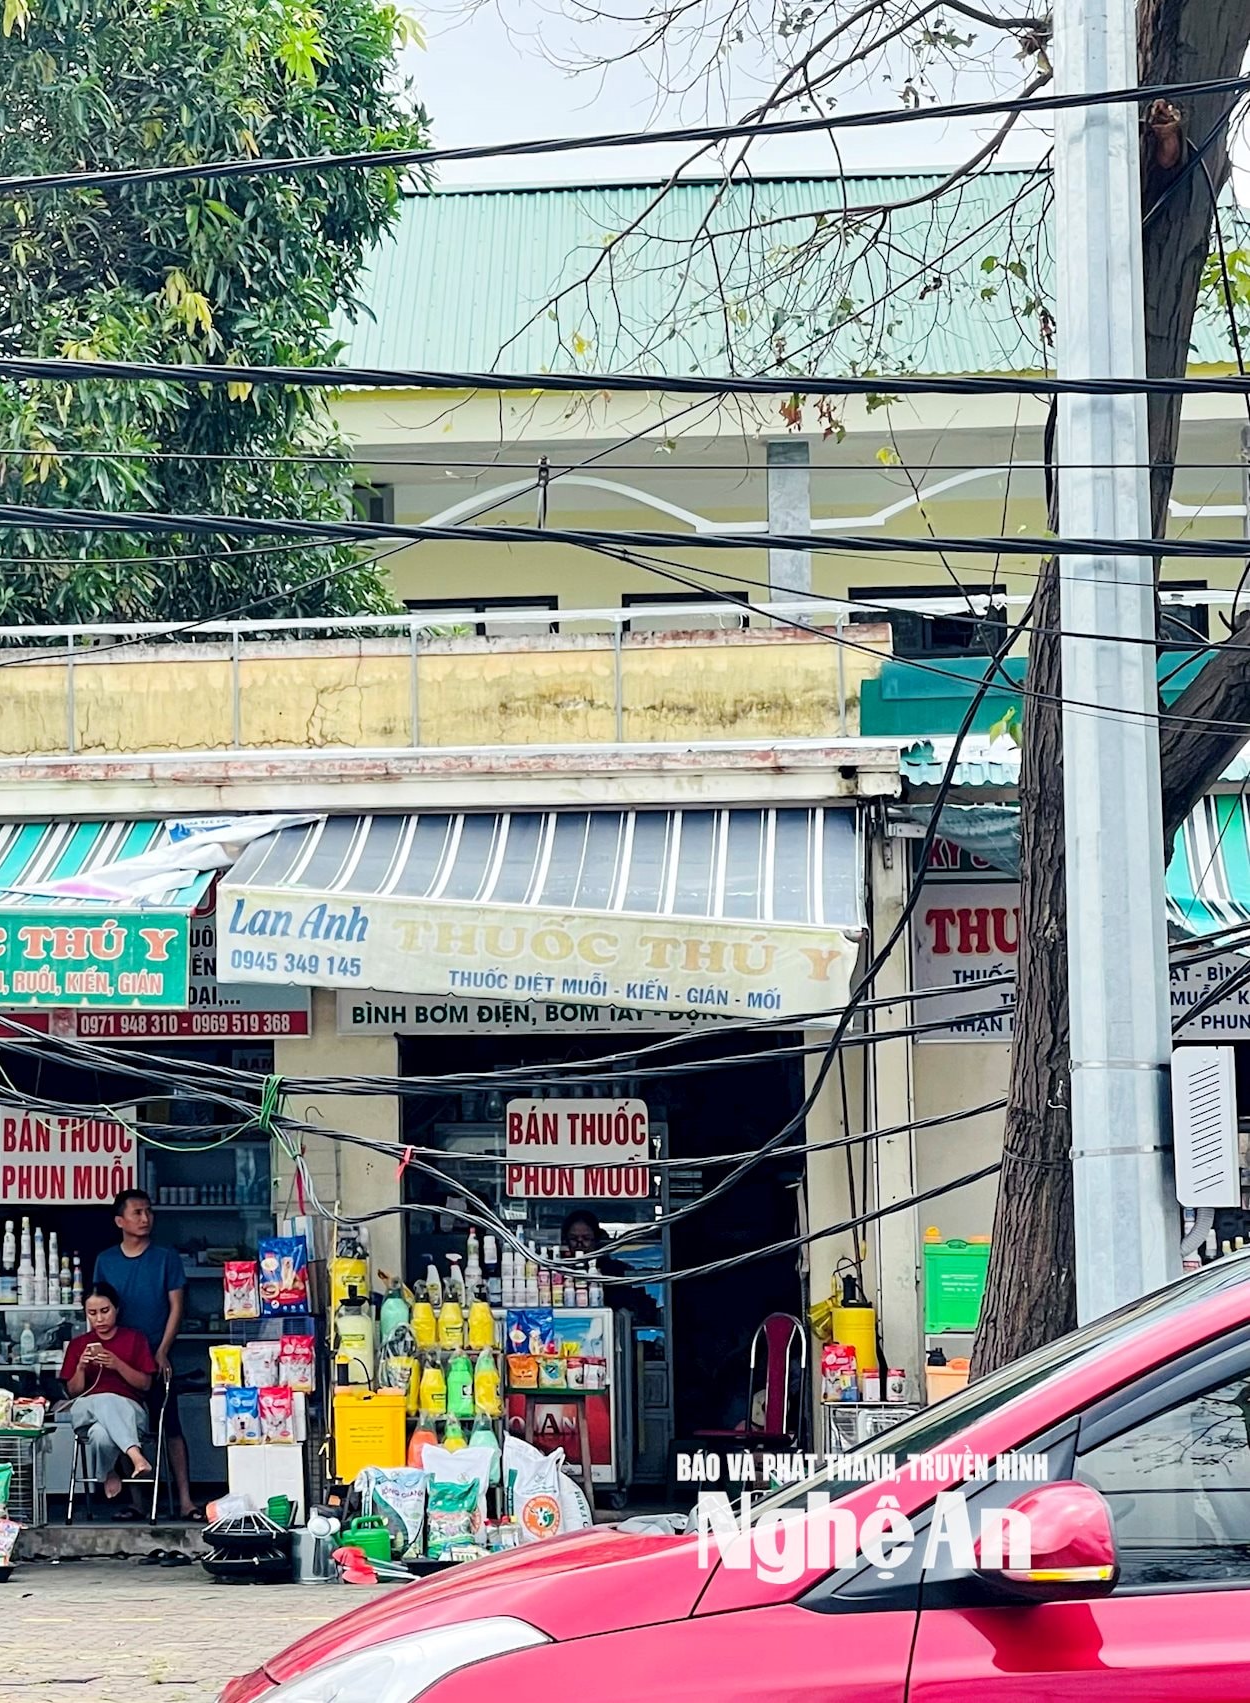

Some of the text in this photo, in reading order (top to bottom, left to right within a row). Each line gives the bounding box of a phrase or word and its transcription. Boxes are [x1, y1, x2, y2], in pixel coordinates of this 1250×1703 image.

[19, 919, 128, 960] THÚ
[139, 927, 179, 961] Y
[229, 898, 369, 942] Lan Anh
[231, 950, 361, 977] 0945 349 145
[392, 915, 841, 982] THUỐC THÚ Y
[65, 965, 114, 996] KIẾN,
[118, 965, 164, 996] GIÁN
[449, 966, 508, 991] THUỐC
[514, 972, 555, 997] DIỆT
[562, 972, 608, 998] MUỖI
[626, 977, 669, 1002] KIẾN
[686, 981, 728, 1006] GIÁN
[747, 984, 781, 1010] MỐI
[81, 1016, 115, 1035] 0971
[121, 1016, 147, 1035] 948
[151, 1015, 177, 1034] 310
[192, 1014, 227, 1033] 0969
[234, 1014, 258, 1032] 519
[263, 1014, 290, 1032] 368
[352, 1001, 406, 1024] BÌNH
[415, 1003, 468, 1024] BƠM
[4, 1111, 50, 1152] BÁN
[509, 1101, 646, 1146] BÁN THUỐC
[3, 1155, 133, 1200] PHUN MUỖI
[508, 1154, 648, 1196] PHUN MUỖI
